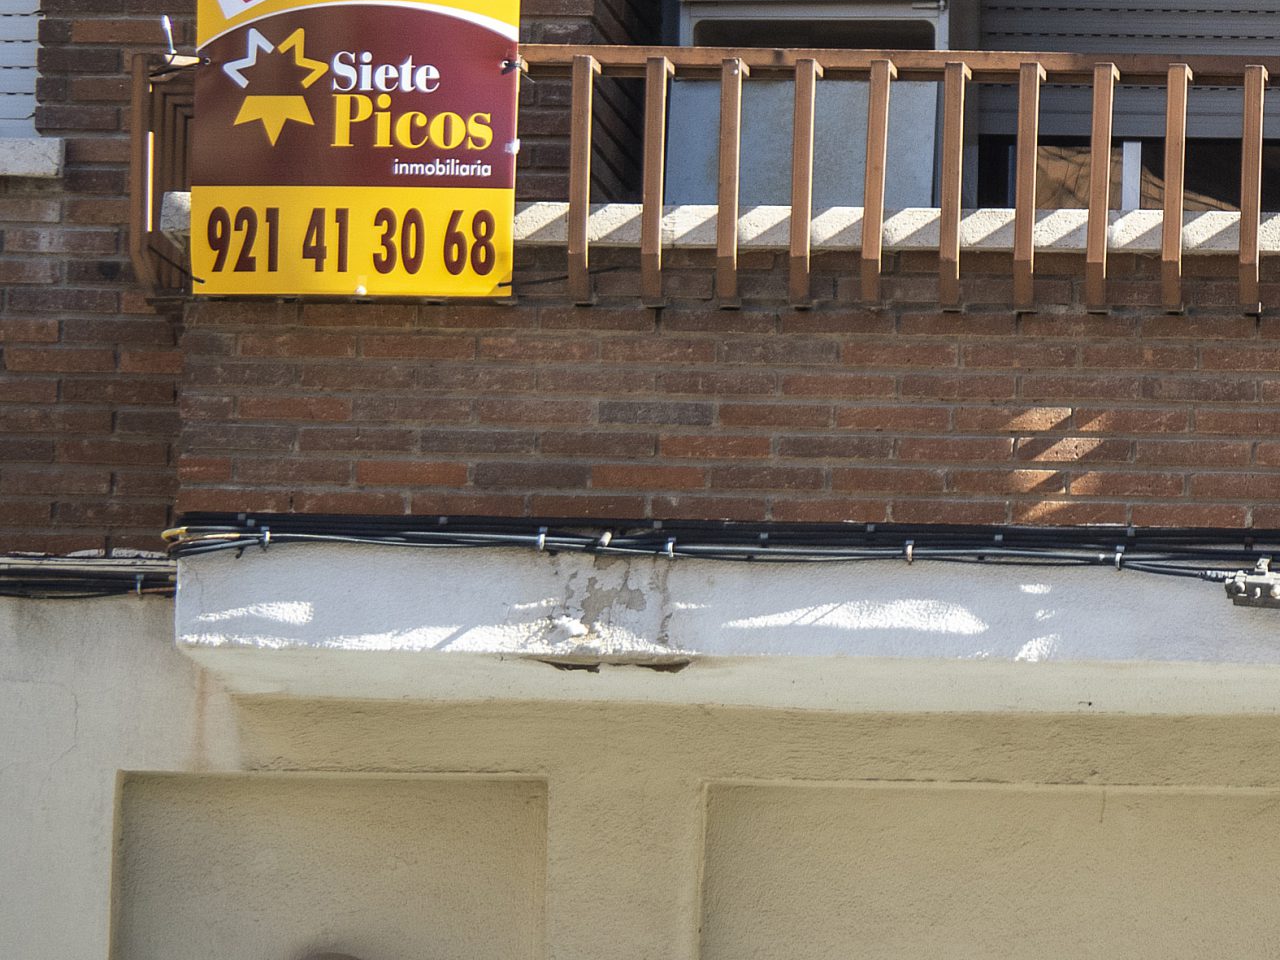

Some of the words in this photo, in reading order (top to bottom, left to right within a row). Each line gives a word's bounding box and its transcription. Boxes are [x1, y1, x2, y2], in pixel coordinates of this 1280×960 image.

[332, 51, 440, 93] Siete
[331, 93, 493, 150] Picos
[394, 158, 492, 176] inmobiliaria
[207, 206, 279, 272] 921
[302, 207, 349, 272] 41
[373, 207, 424, 274] 30
[443, 209, 496, 275] 68
